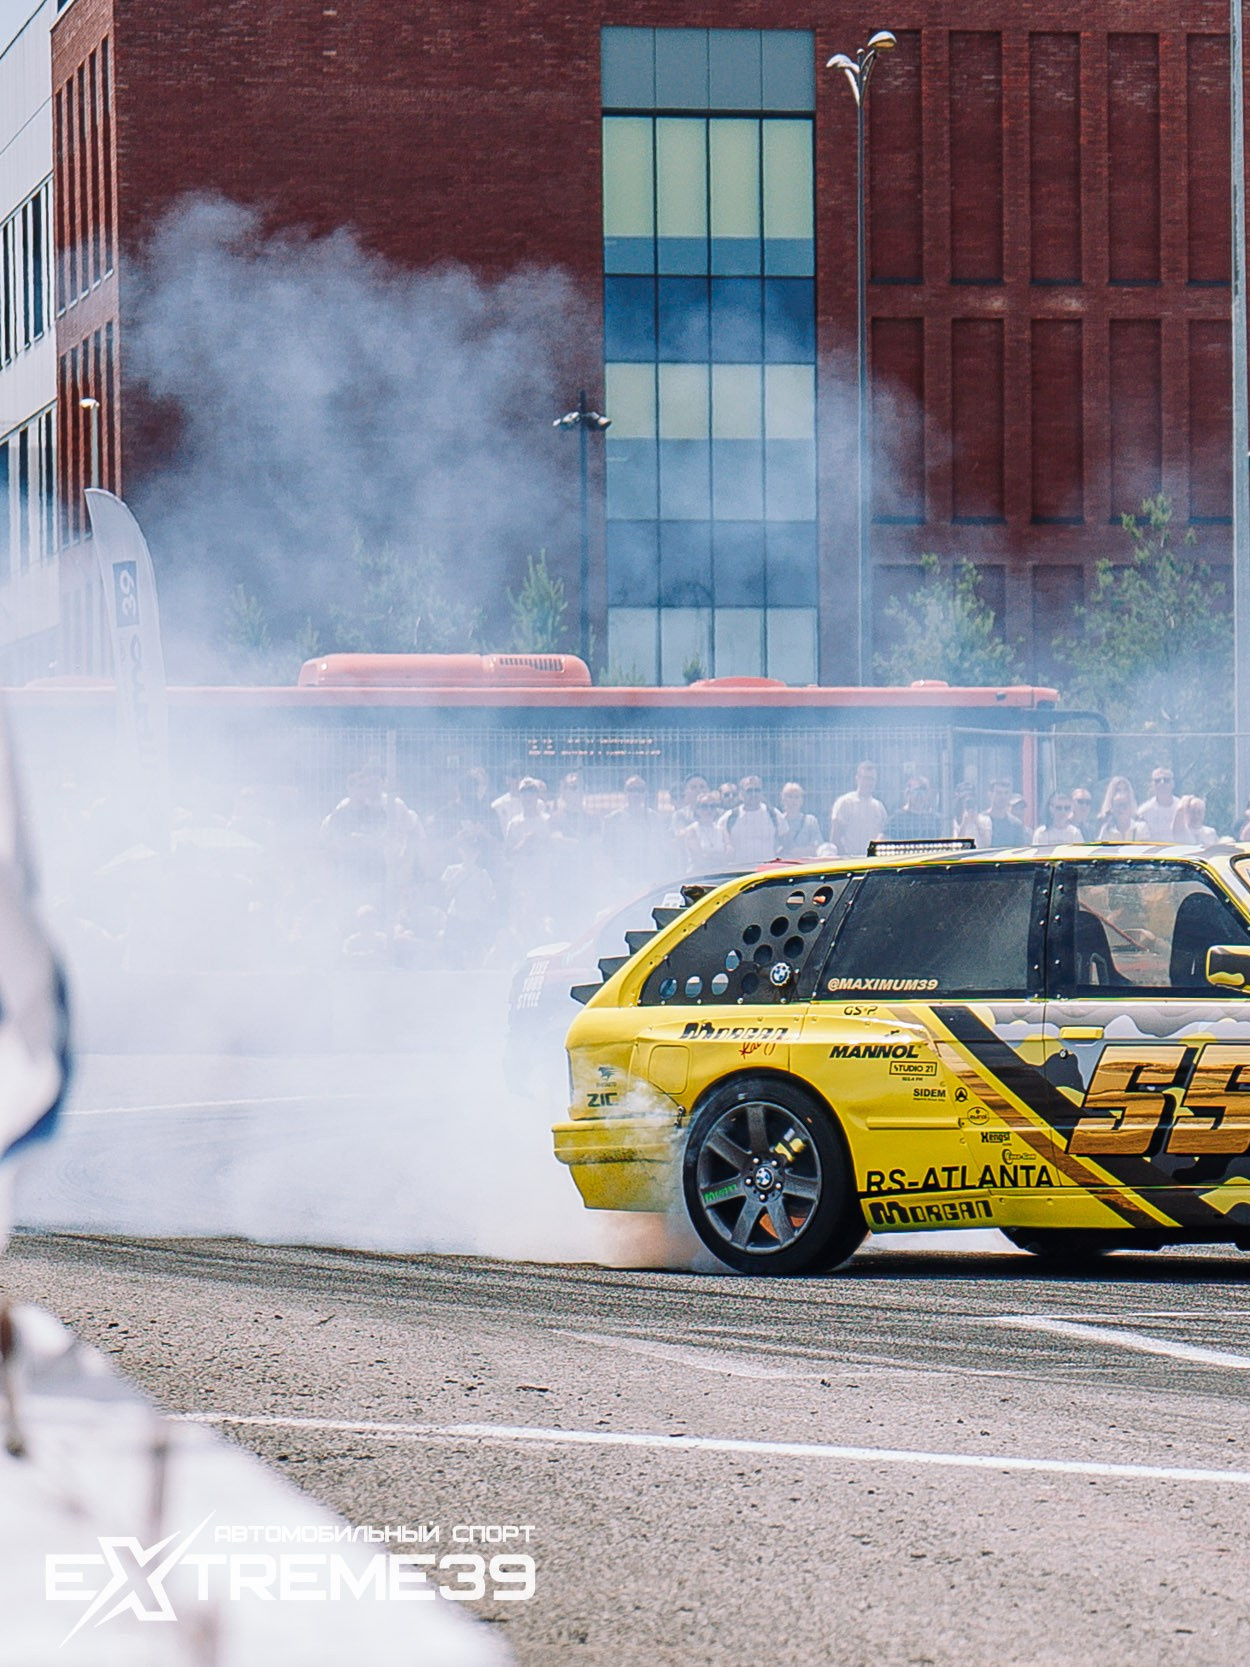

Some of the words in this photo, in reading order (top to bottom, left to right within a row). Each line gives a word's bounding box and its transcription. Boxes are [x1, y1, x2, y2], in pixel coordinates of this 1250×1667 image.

[827, 977, 939, 992] @MAXIMUM39
[829, 1045, 919, 1059] MANNOL
[893, 1064, 923, 1073] STUDIO
[925, 1065, 934, 1073] 21
[586, 1092, 619, 1108] ZIC
[913, 1088, 946, 1098] SIDEM
[866, 1165, 1055, 1192] RS-ATLANTA
